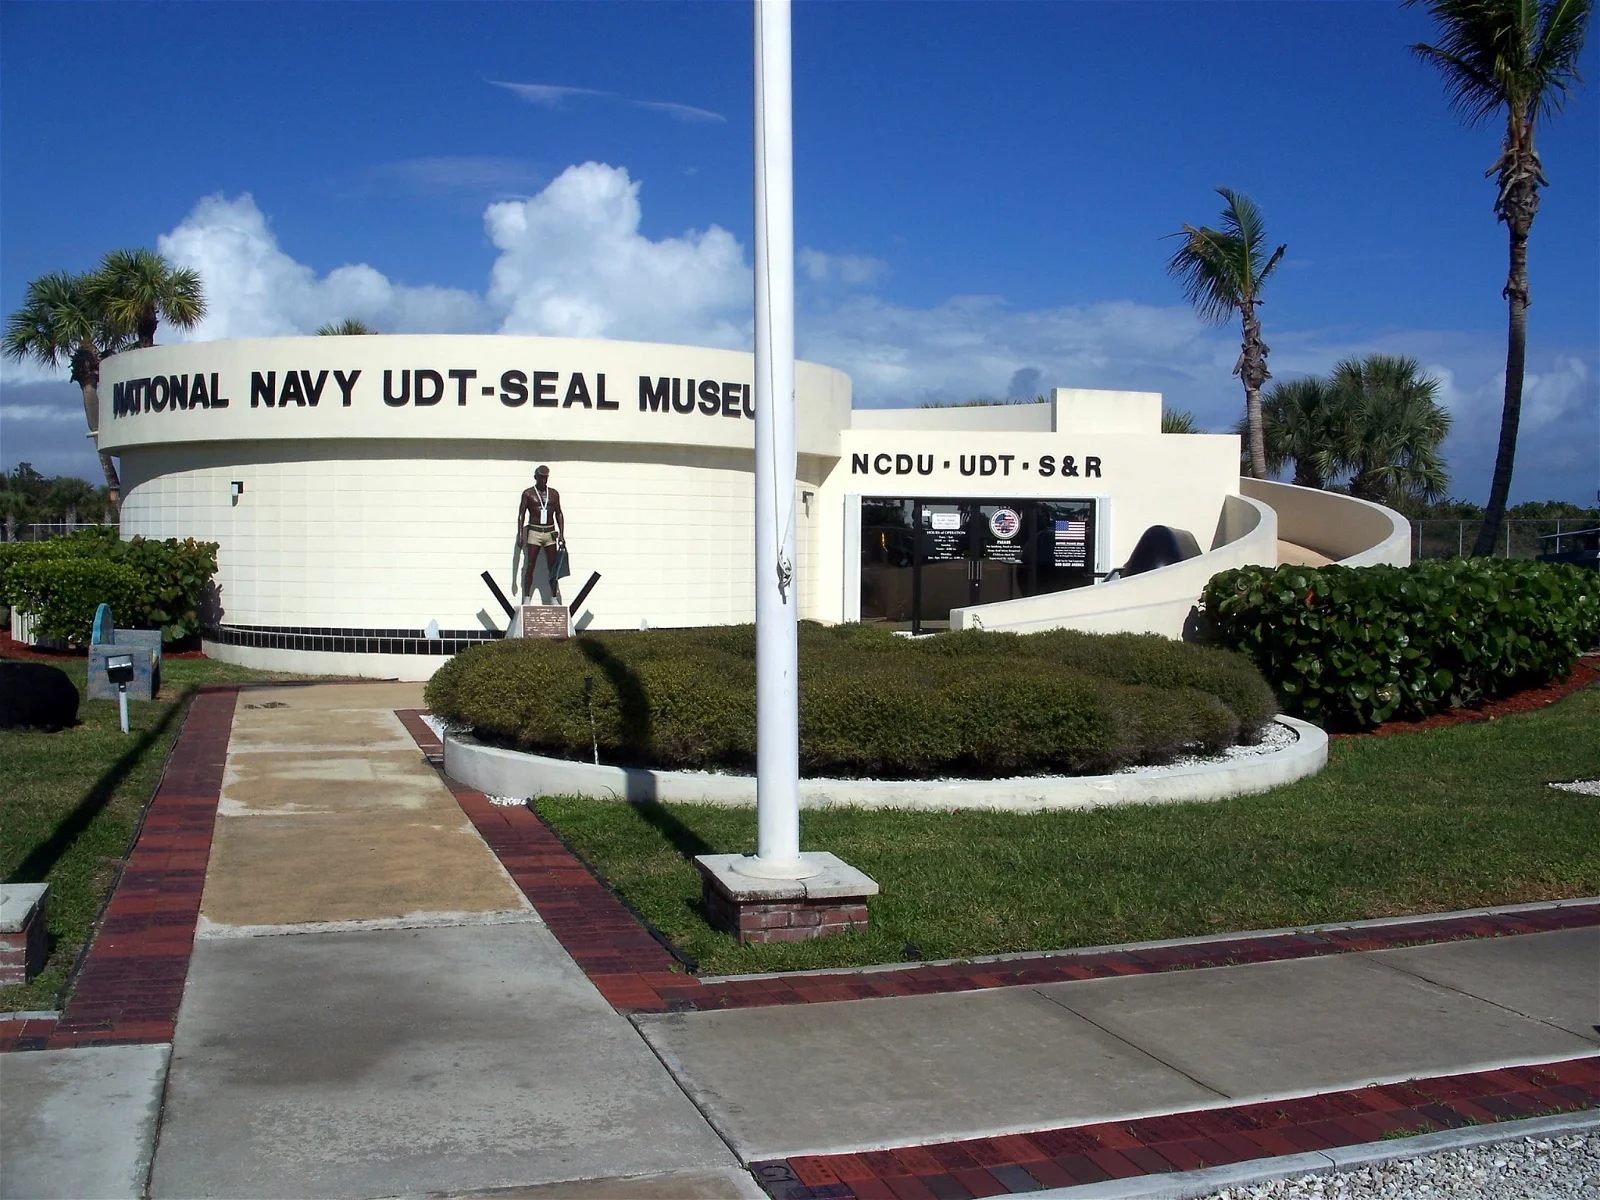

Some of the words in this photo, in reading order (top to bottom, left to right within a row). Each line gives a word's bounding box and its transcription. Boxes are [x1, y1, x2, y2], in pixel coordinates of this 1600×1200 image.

[113, 372, 230, 420] NATIONAL
[250, 370, 362, 408] NAVY
[383, 369, 620, 411] UDT-SEAL
[638, 375, 756, 421] MUSEU
[851, 453, 934, 475] NCDU
[959, 454, 1015, 476] UDT
[1038, 455, 1102, 478] S&R
